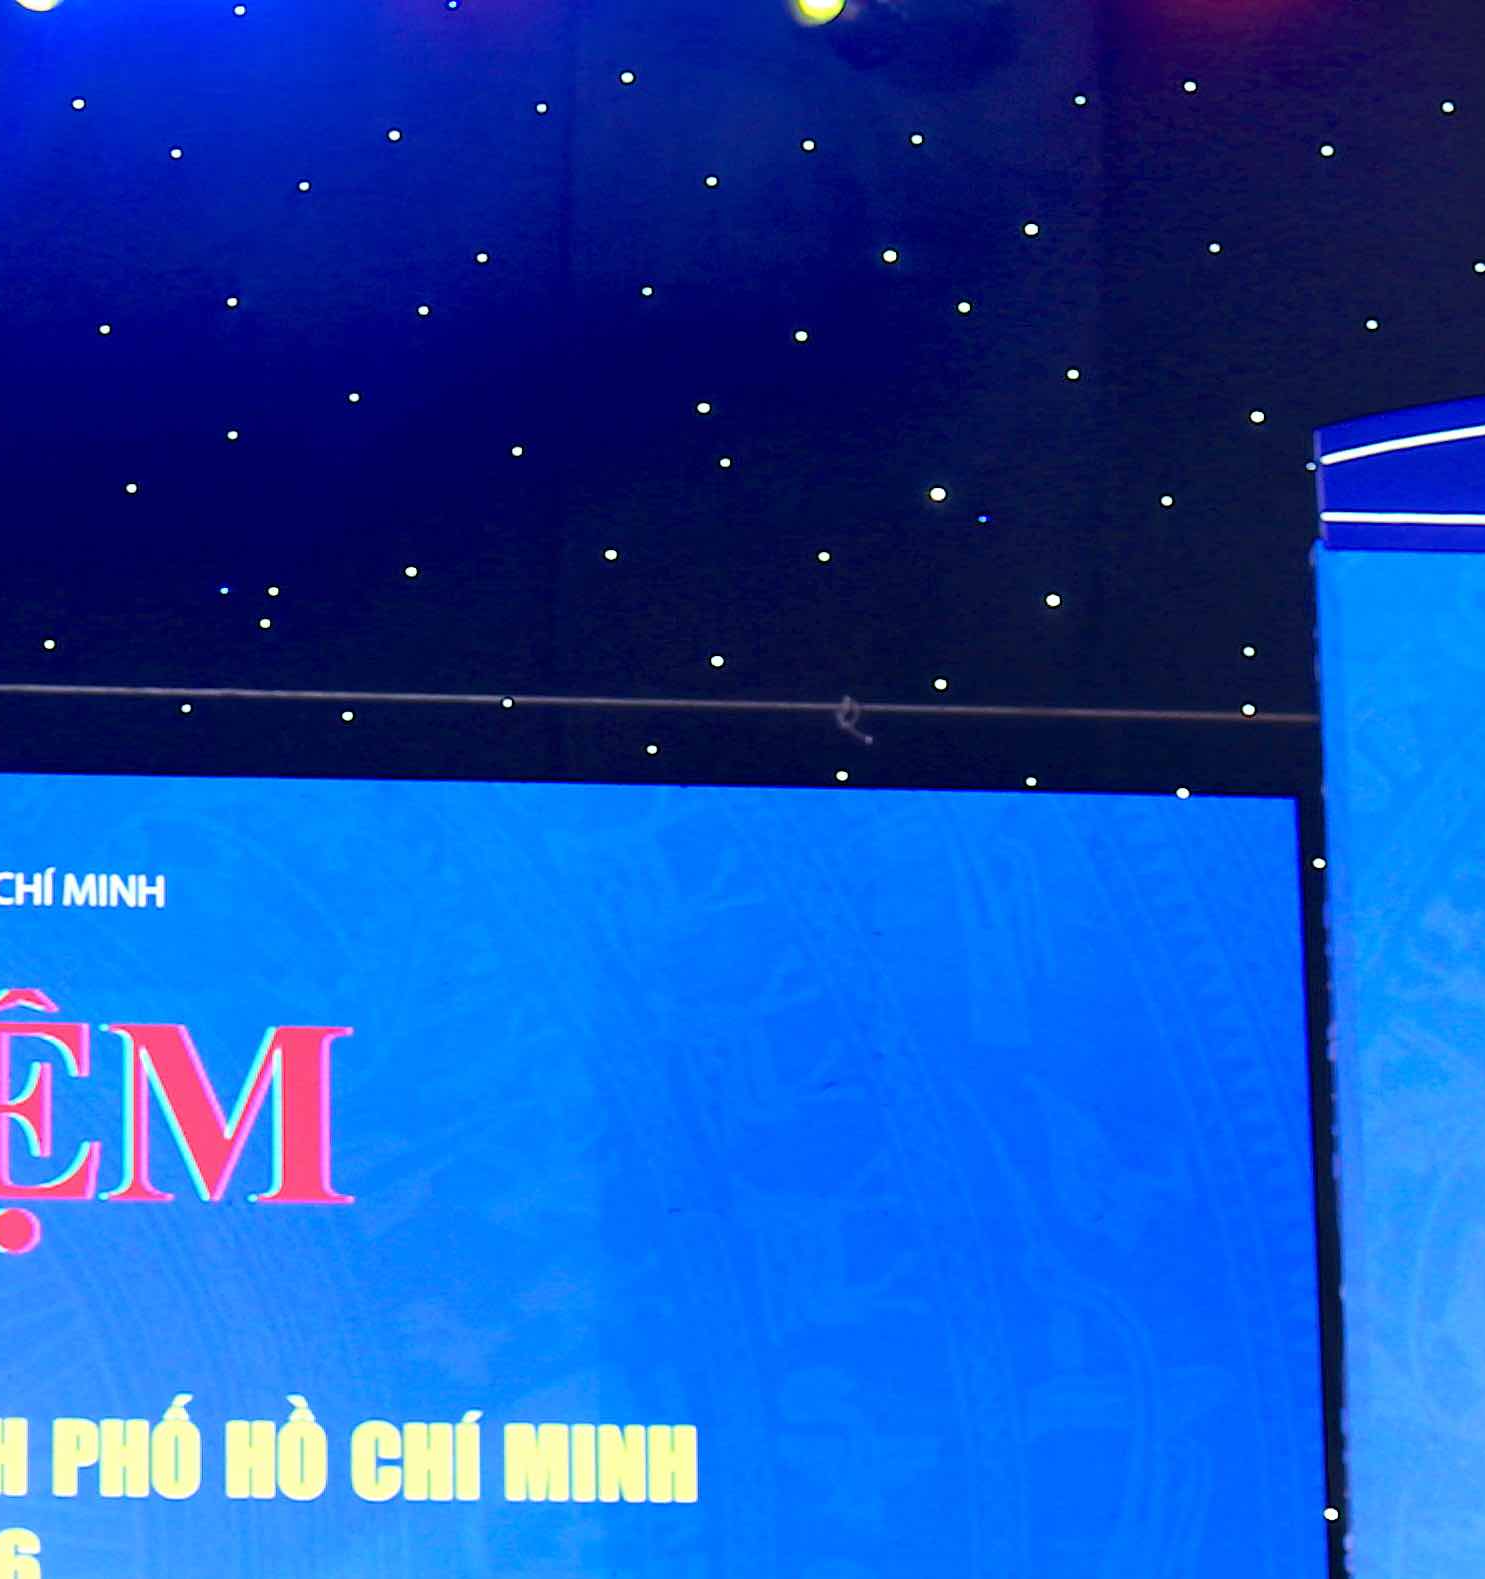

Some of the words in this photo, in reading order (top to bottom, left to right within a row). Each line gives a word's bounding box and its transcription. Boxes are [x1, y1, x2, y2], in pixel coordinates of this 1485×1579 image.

[63, 872, 165, 908] MINH
[52, 1392, 201, 1500] PHỐ
[226, 1393, 329, 1503] HỒ
[351, 1410, 484, 1503] CHÍ
[504, 1422, 698, 1504] MINH
